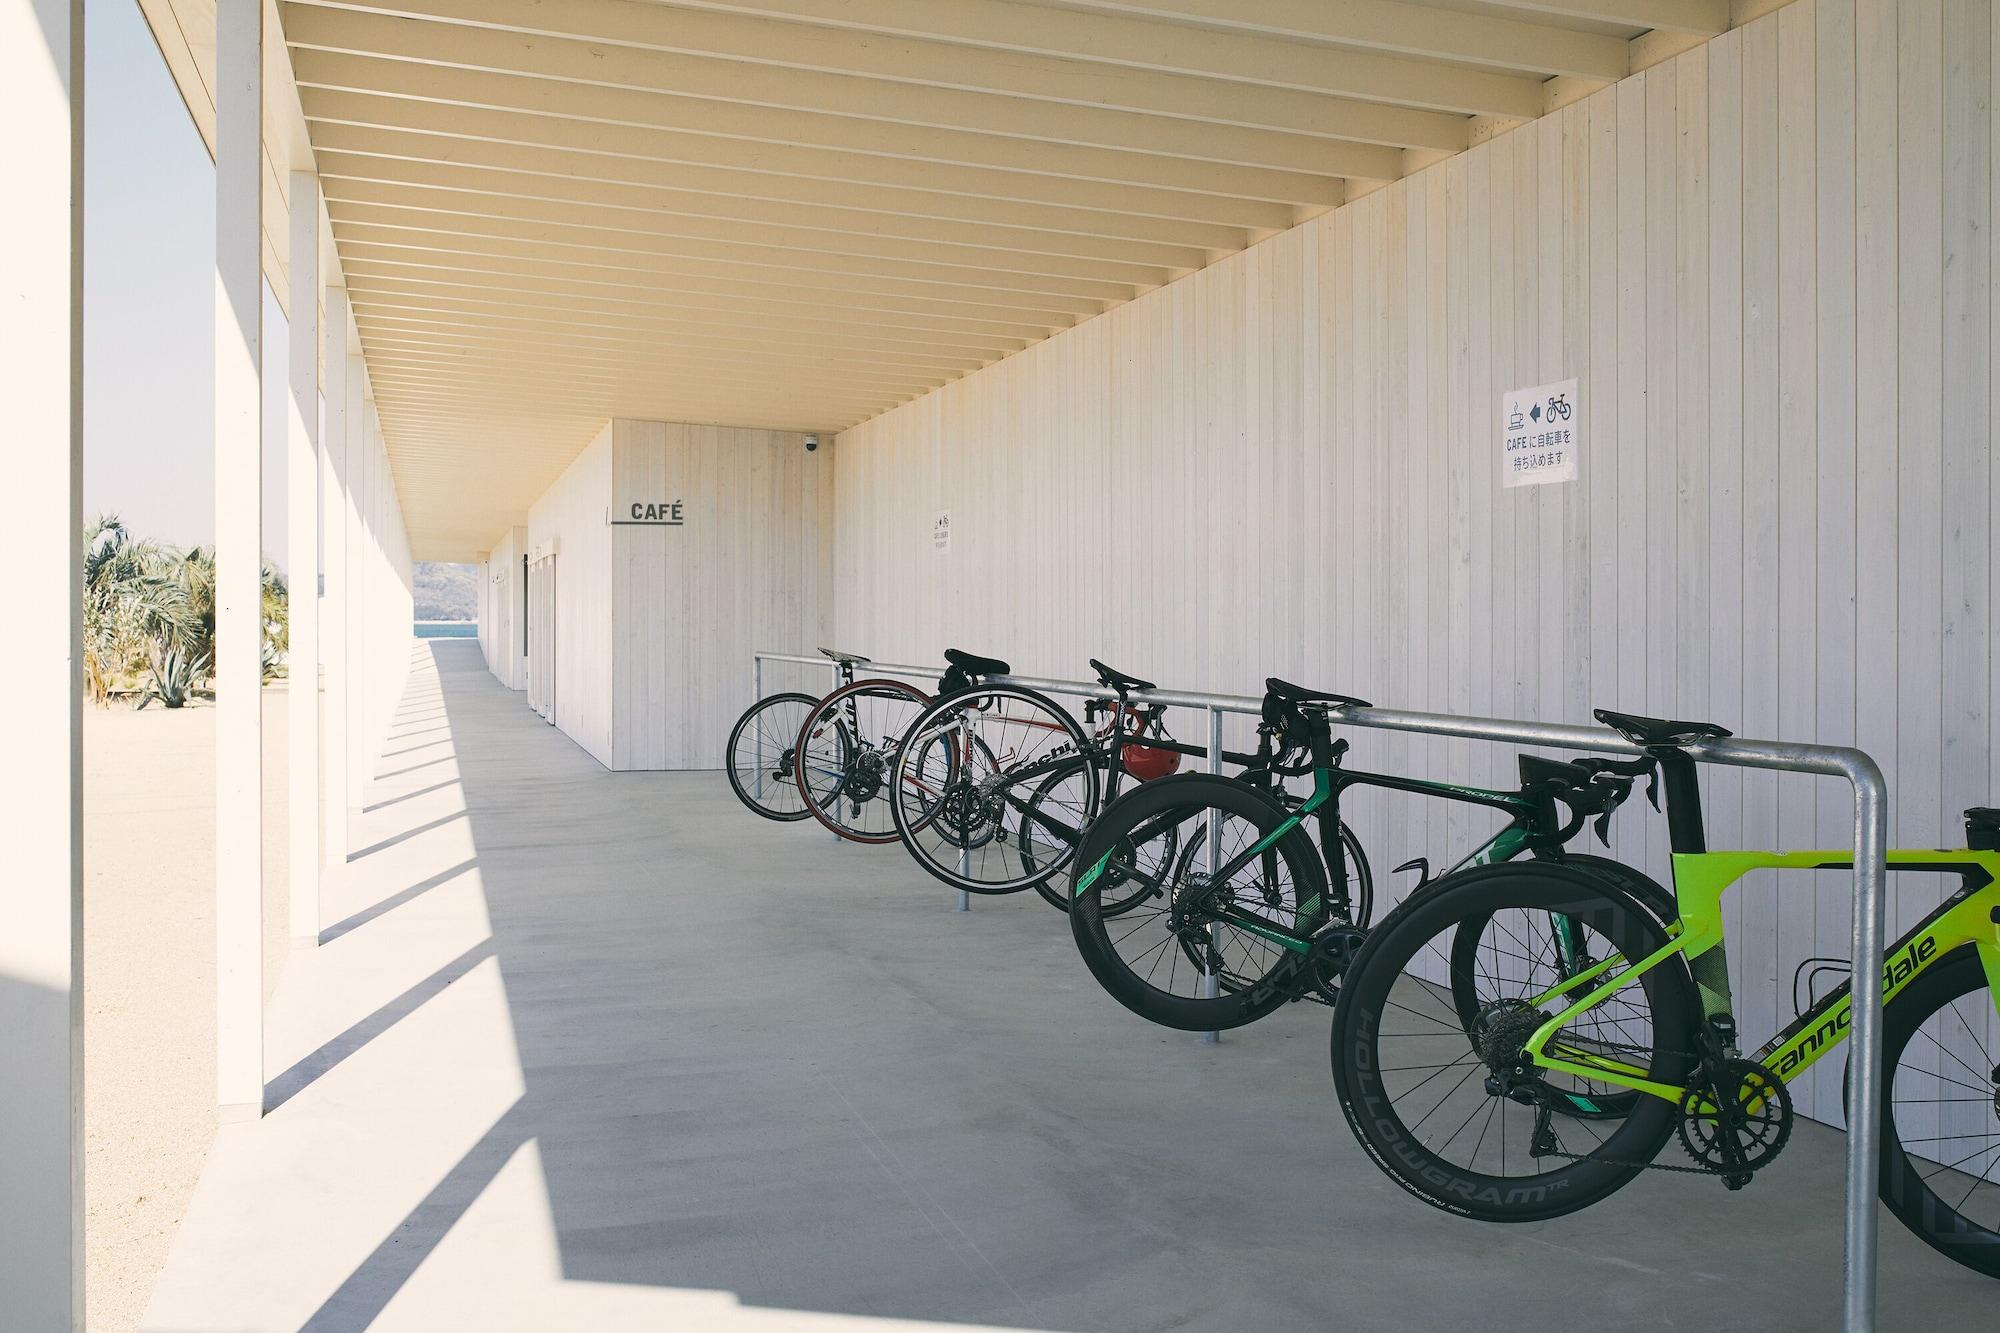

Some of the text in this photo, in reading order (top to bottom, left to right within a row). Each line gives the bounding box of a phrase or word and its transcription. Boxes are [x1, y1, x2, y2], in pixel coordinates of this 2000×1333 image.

[1506, 436, 1527, 451] CAFE
[1514, 450, 1563, 471] 持ち込めます
[631, 499, 683, 520] CAFÉ
[1449, 786, 1512, 803] PROPEL
[1355, 1008, 1546, 1205] HOLLOWGRAM
[1405, 1182, 1446, 1207] RUBINO
